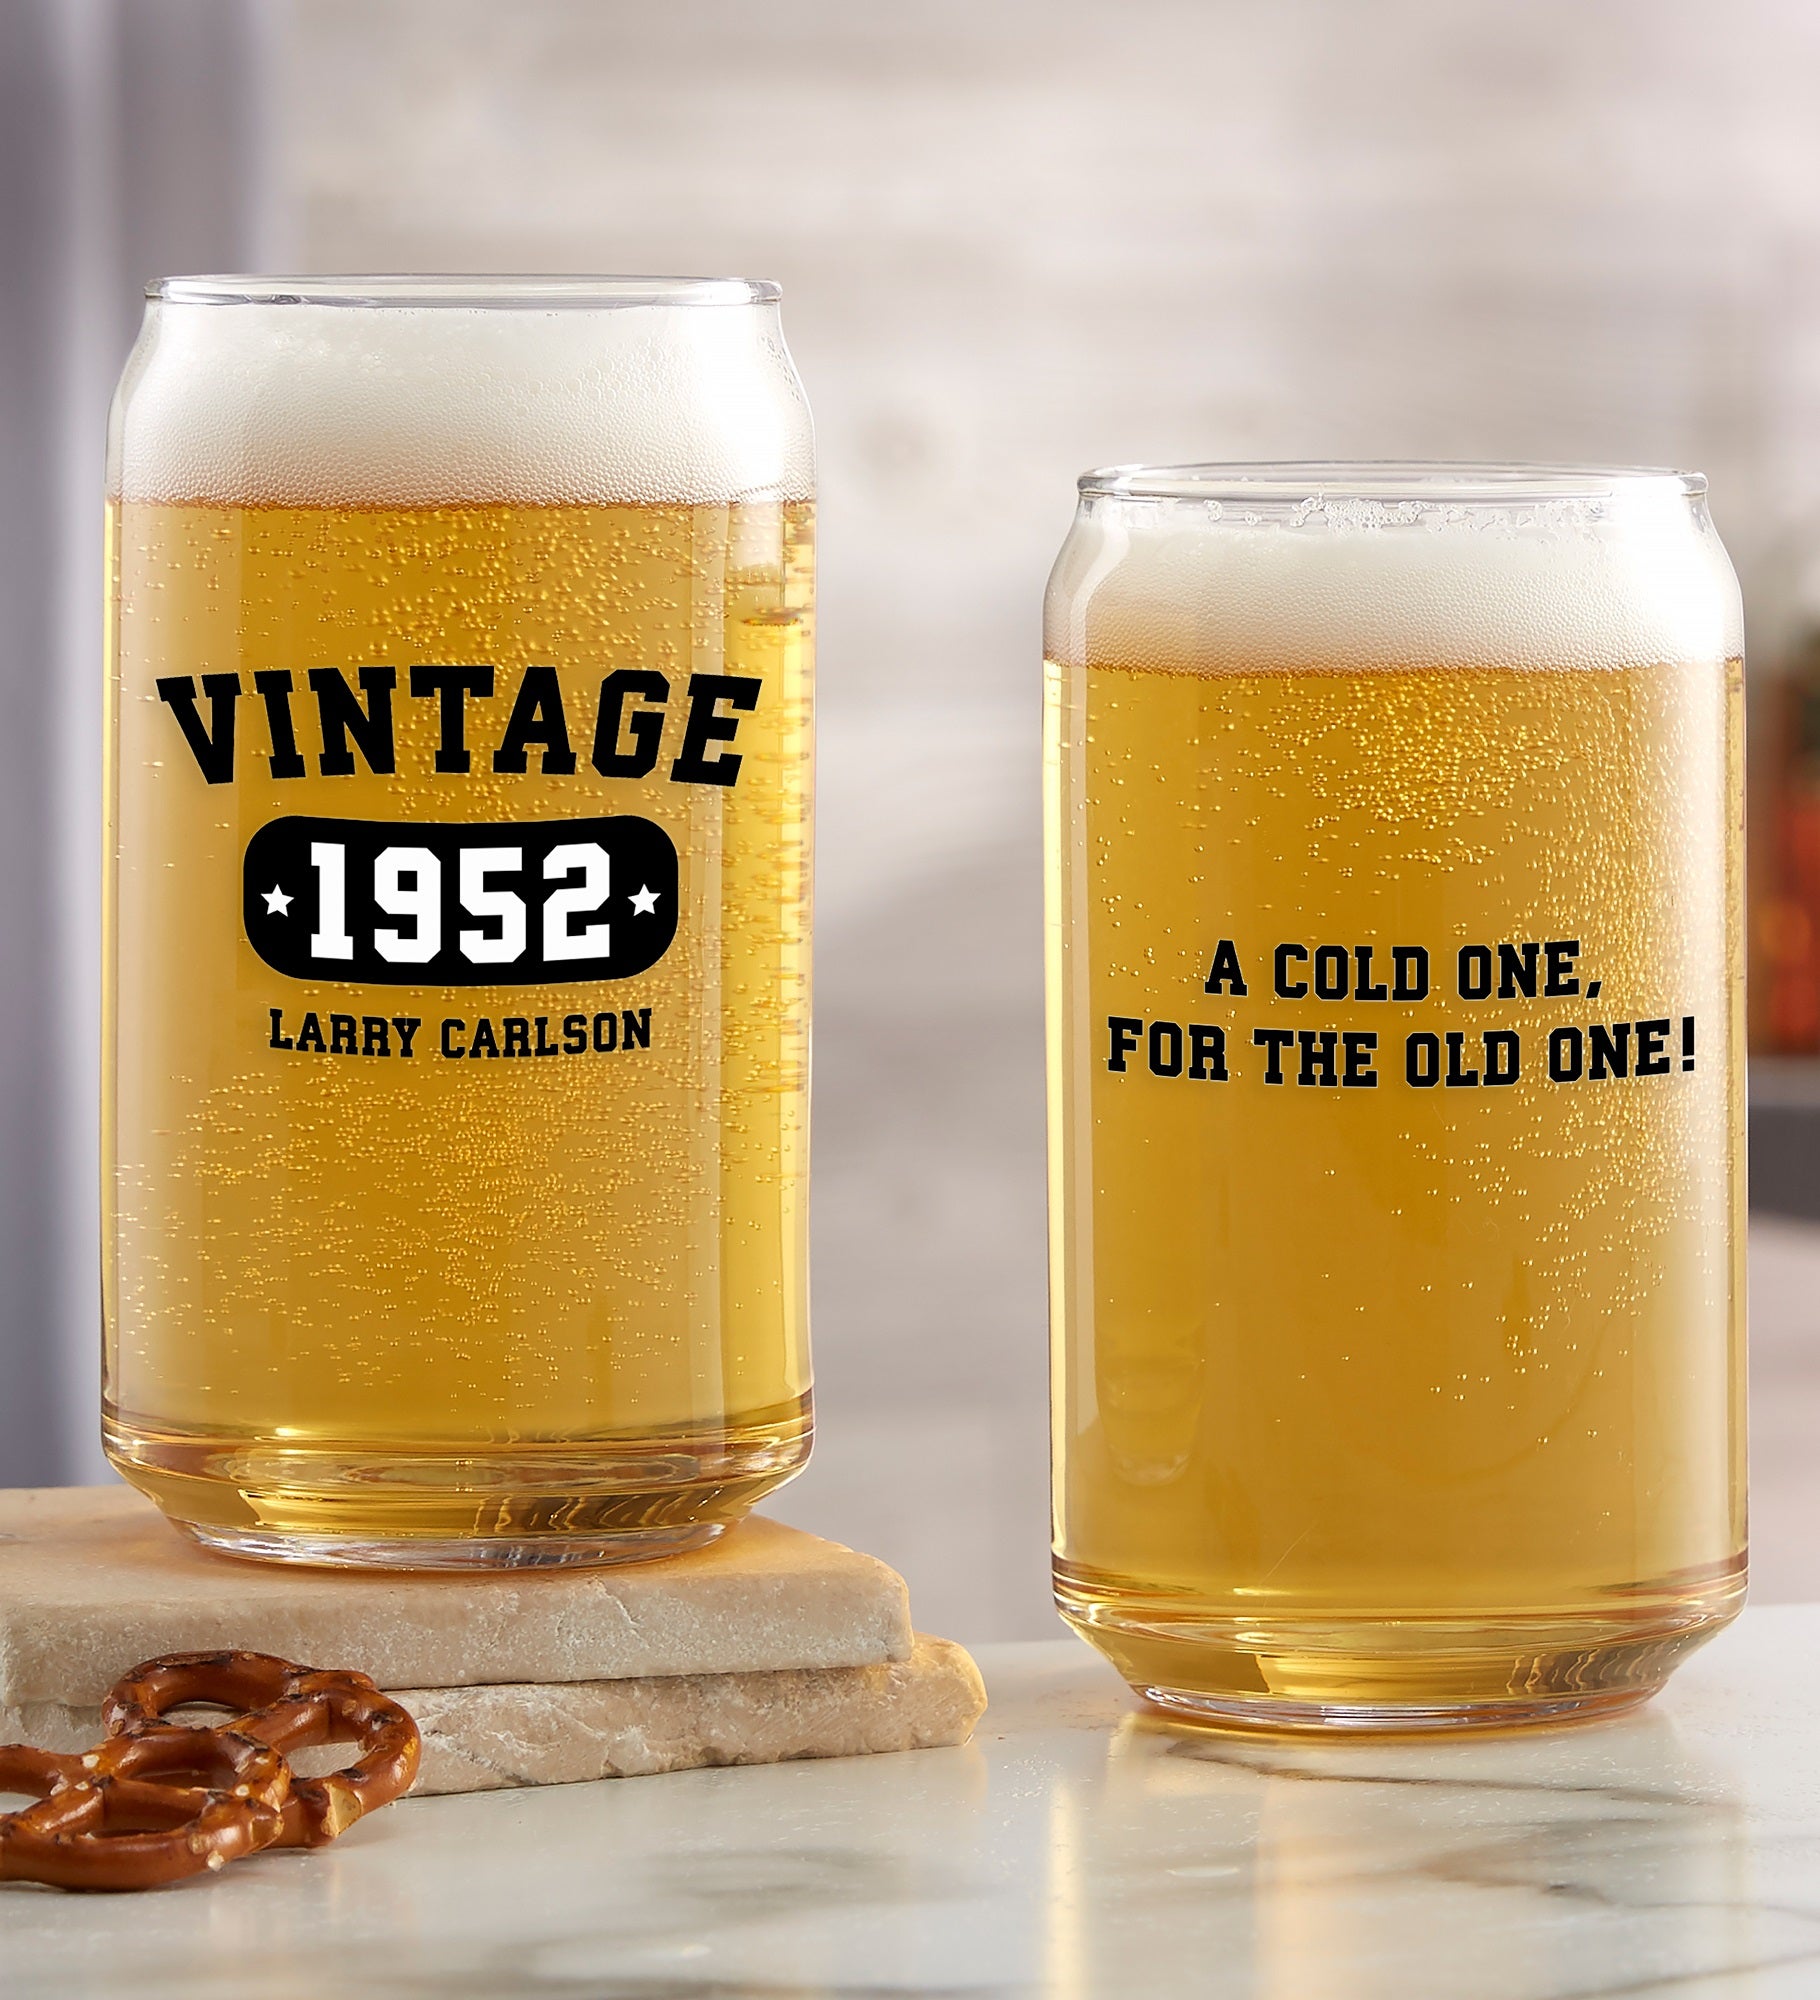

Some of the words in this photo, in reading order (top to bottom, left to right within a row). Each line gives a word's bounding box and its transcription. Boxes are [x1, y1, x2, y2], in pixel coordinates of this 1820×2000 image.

[156, 666, 763, 787] VINTAGE
[310, 841, 611, 964] 1952
[1204, 939, 1248, 997] A
[1274, 943, 1429, 1001] COLD
[1458, 940, 1602, 1000] ONE,
[269, 1008, 422, 1058] LARRY
[441, 1007, 653, 1059] CARLSON
[1108, 1016, 1229, 1082] FOR
[1253, 1028, 1378, 1088] THE
[1406, 1030, 1520, 1088] OLD
[1548, 1016, 1696, 1083] ONE!
